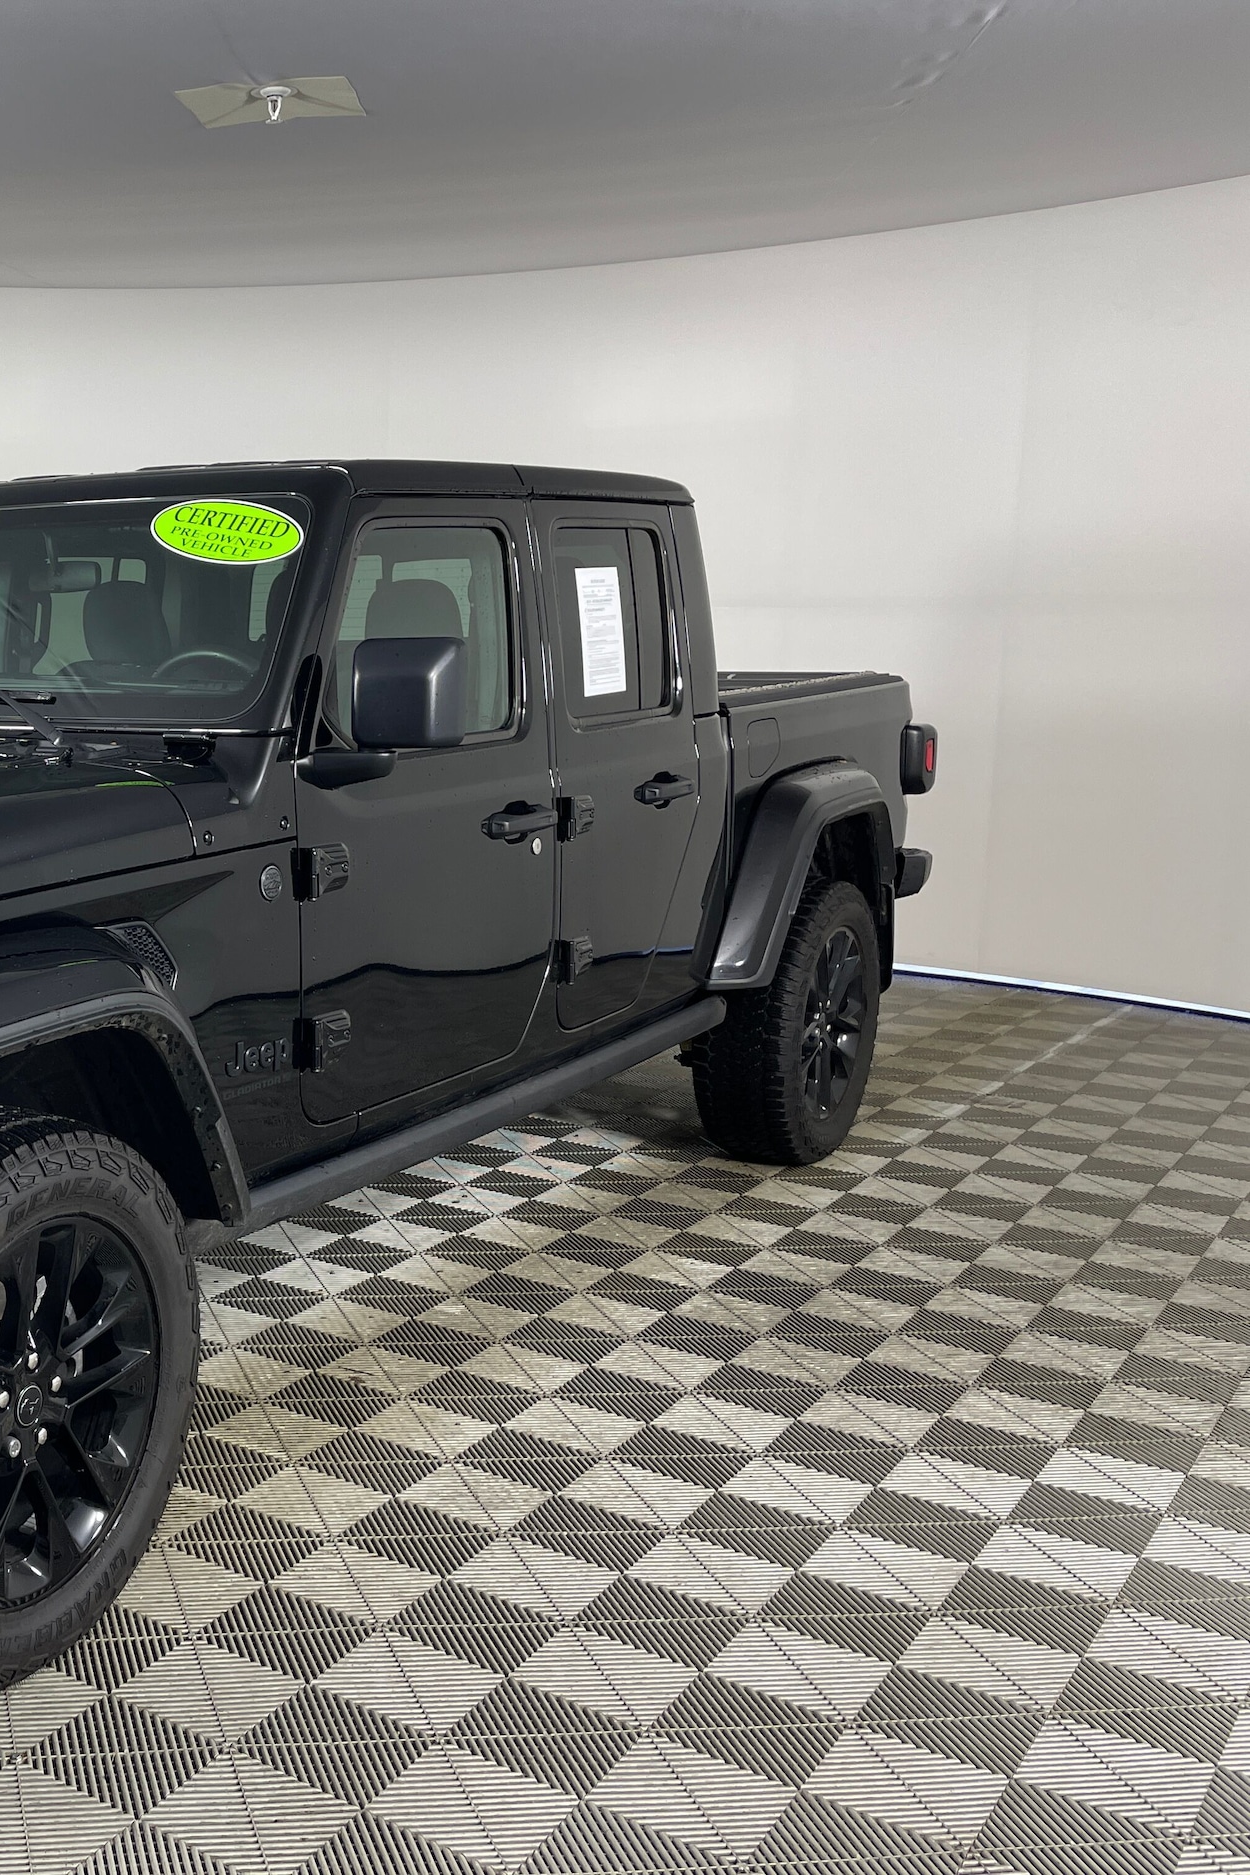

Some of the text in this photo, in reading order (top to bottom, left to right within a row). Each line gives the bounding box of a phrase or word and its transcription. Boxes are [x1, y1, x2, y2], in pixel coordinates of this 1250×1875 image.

[175, 506, 290, 538] CERTIFIED
[170, 526, 272, 550] PRE-OWNED
[181, 538, 252, 558] VEHICLE
[224, 1037, 291, 1078] Jeep
[222, 1076, 281, 1101] GLADIATOR
[5, 1177, 139, 1231] GENERAL
